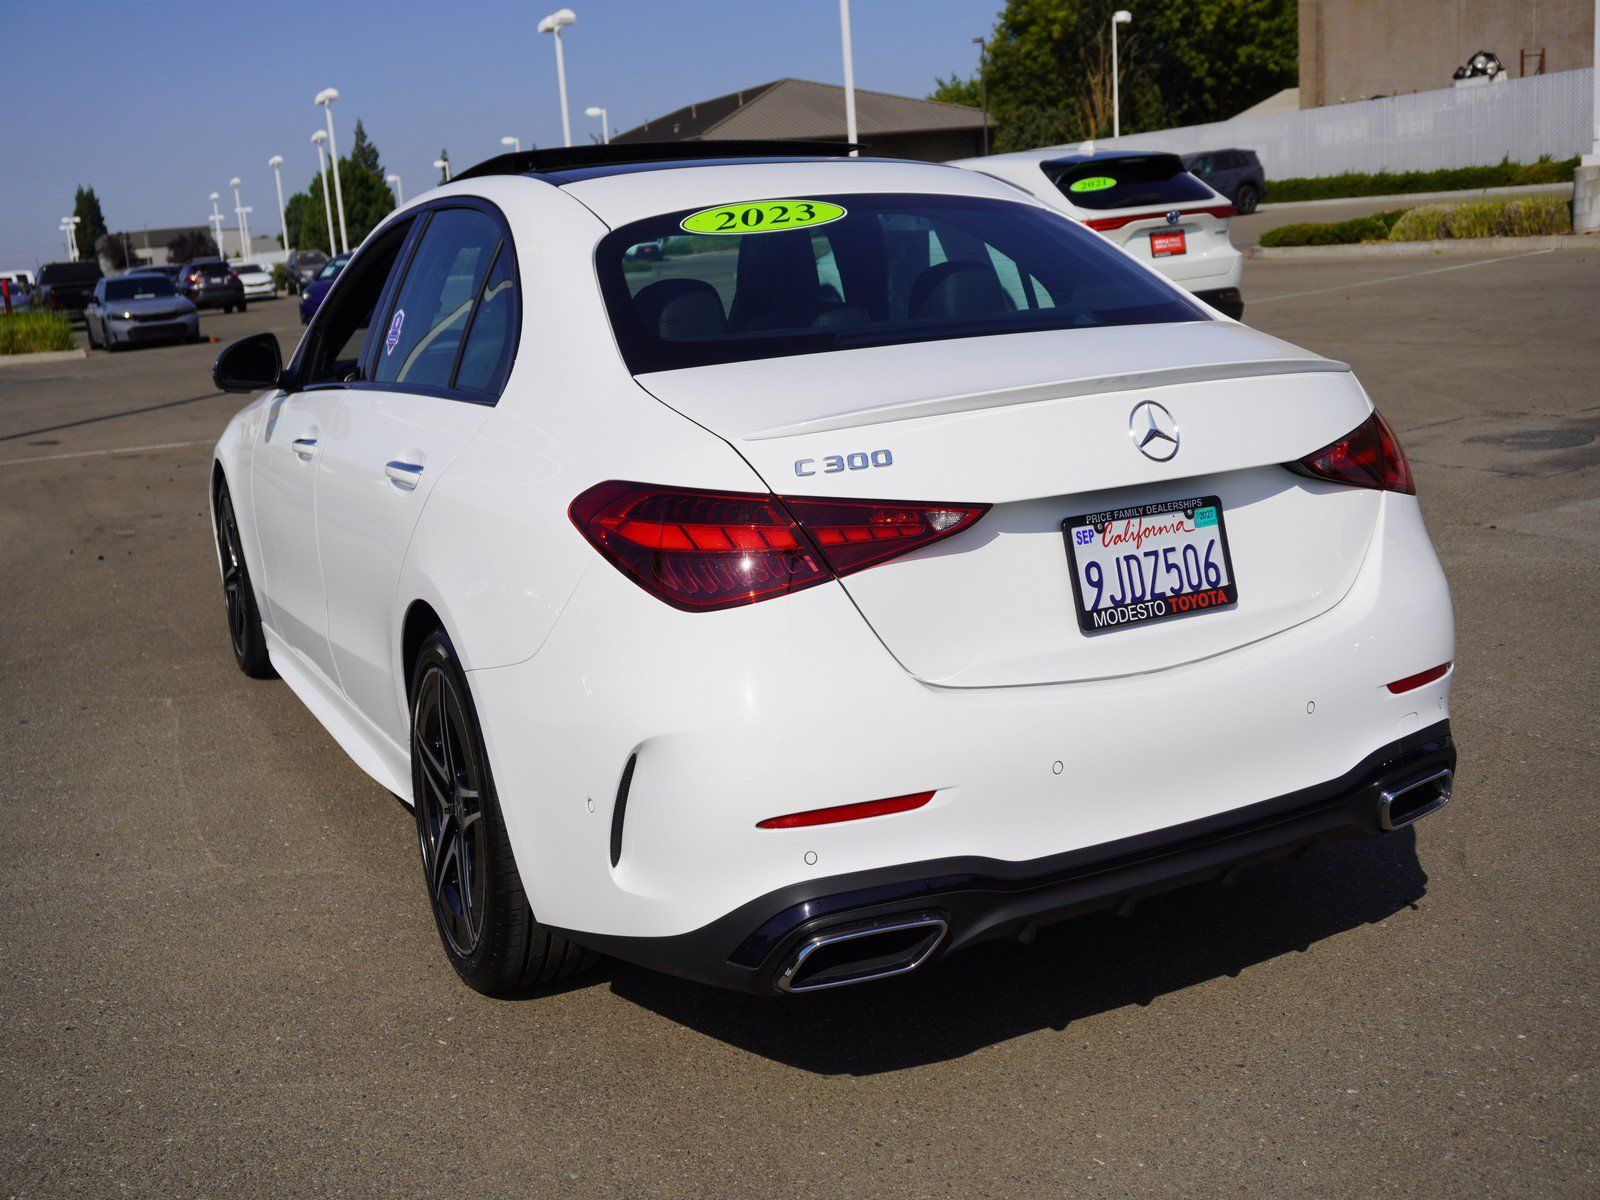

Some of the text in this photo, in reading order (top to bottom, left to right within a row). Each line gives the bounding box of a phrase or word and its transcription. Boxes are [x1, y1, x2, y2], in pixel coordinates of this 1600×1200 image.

[715, 203, 816, 231] 2023
[794, 449, 893, 477] C 300
[1086, 498, 1203, 524] PRICE FAMILY DEALERSHIPS
[1075, 528, 1095, 546] SEP
[1101, 515, 1196, 549] California
[1084, 538, 1222, 612] 9JDZ506
[1093, 589, 1231, 628] MODESTO TOYOTA
